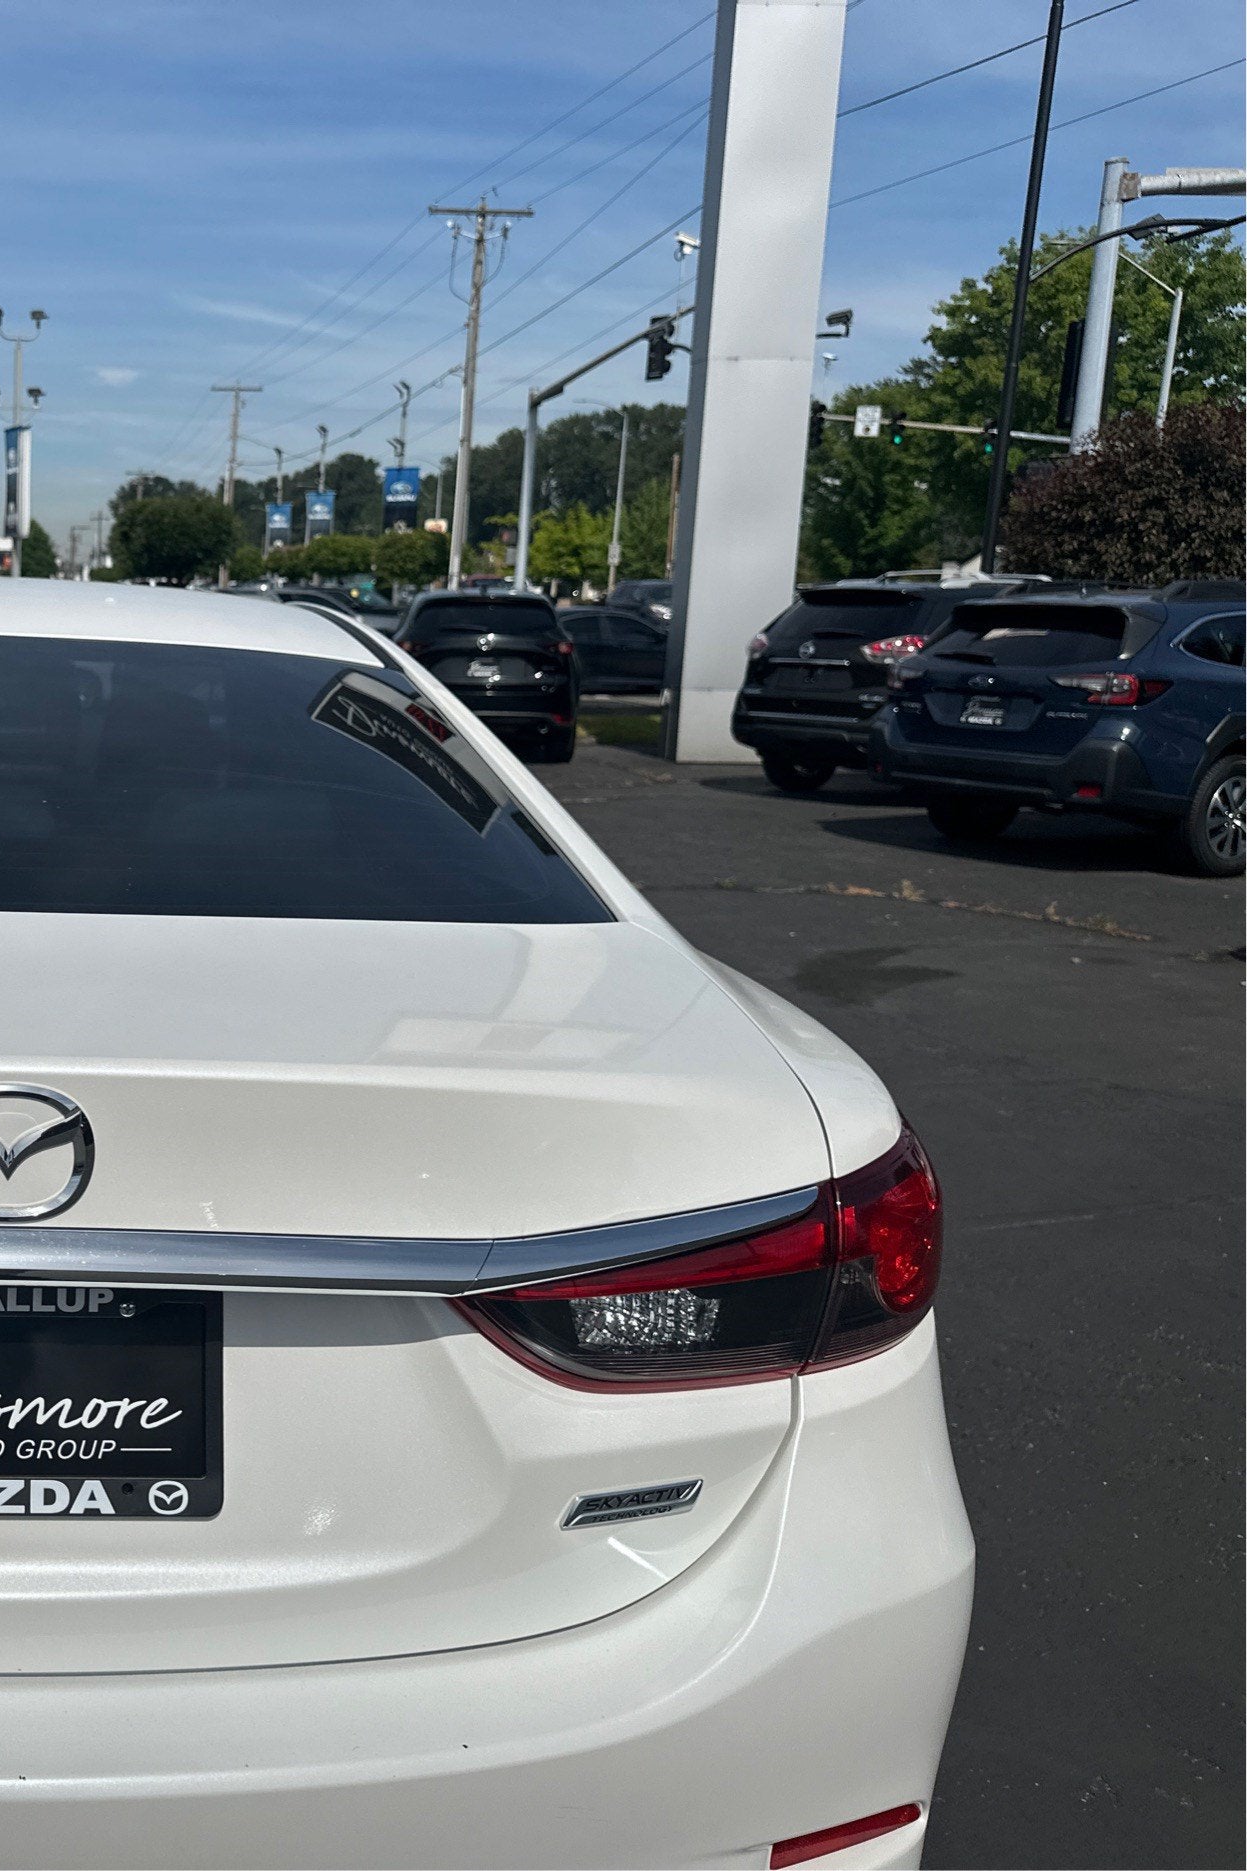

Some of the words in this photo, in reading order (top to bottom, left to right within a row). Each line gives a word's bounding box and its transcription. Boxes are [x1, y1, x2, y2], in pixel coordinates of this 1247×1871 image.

[16, 1440, 117, 1460] GROUP
[583, 1486, 692, 1512] SKYACTIV
[592, 1505, 674, 1522] TECHNOLOGY
